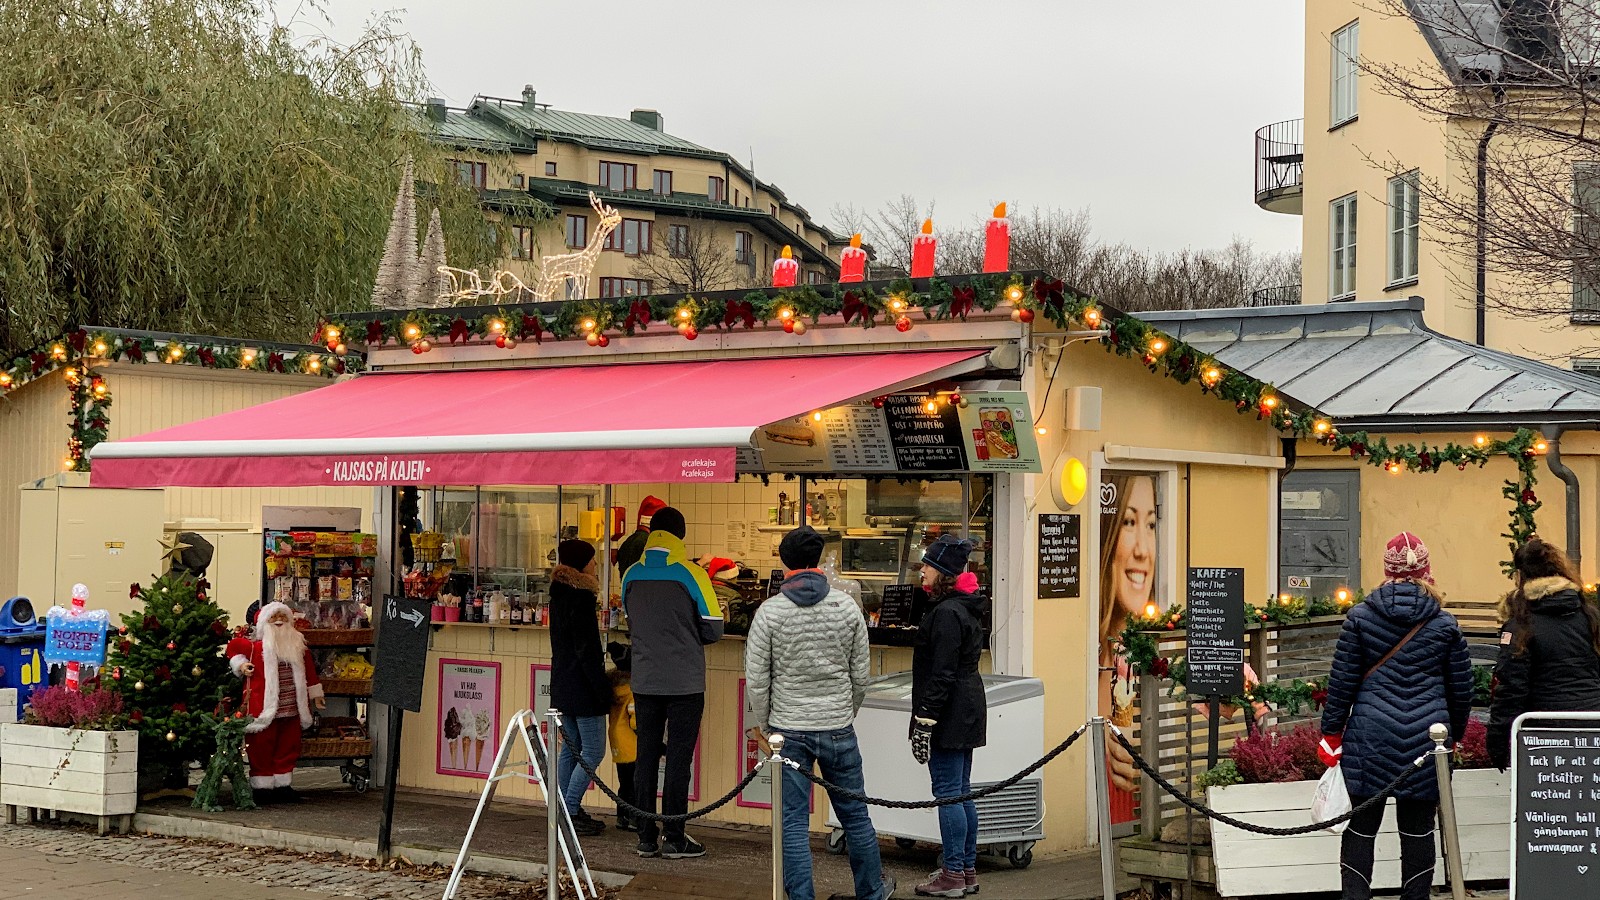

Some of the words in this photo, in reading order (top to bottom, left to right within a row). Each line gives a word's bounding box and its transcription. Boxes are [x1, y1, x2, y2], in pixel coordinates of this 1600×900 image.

[333, 461, 374, 481] KAJSAS
[374, 456, 388, 481] PÅ
[390, 460, 425, 481] KAJEN
[682, 459, 716, 468] @cafekajsa
[682, 469, 714, 478] #cafekajsa
[1197, 569, 1226, 578] KAFFE
[386, 598, 397, 620] Kö
[52, 630, 99, 642] NORTH
[57, 640, 92, 650] POLE
[1523, 736, 1570, 746] Välkommen
[1575, 736, 1587, 747] till
[1529, 756, 1549, 766] Tack
[1555, 756, 1566, 767] för
[1572, 756, 1586, 766] att
[1593, 756, 1600, 766] d
[1538, 772, 1584, 784] fortsätter
[1531, 789, 1570, 800] avstånd
[1579, 790, 1582, 799] i
[1525, 812, 1567, 824] Vänligen
[1576, 812, 1595, 822] håll
[1534, 827, 1588, 838] gångbanan
[1528, 842, 1584, 854] barnvagnar
[1590, 842, 1597, 854] &
